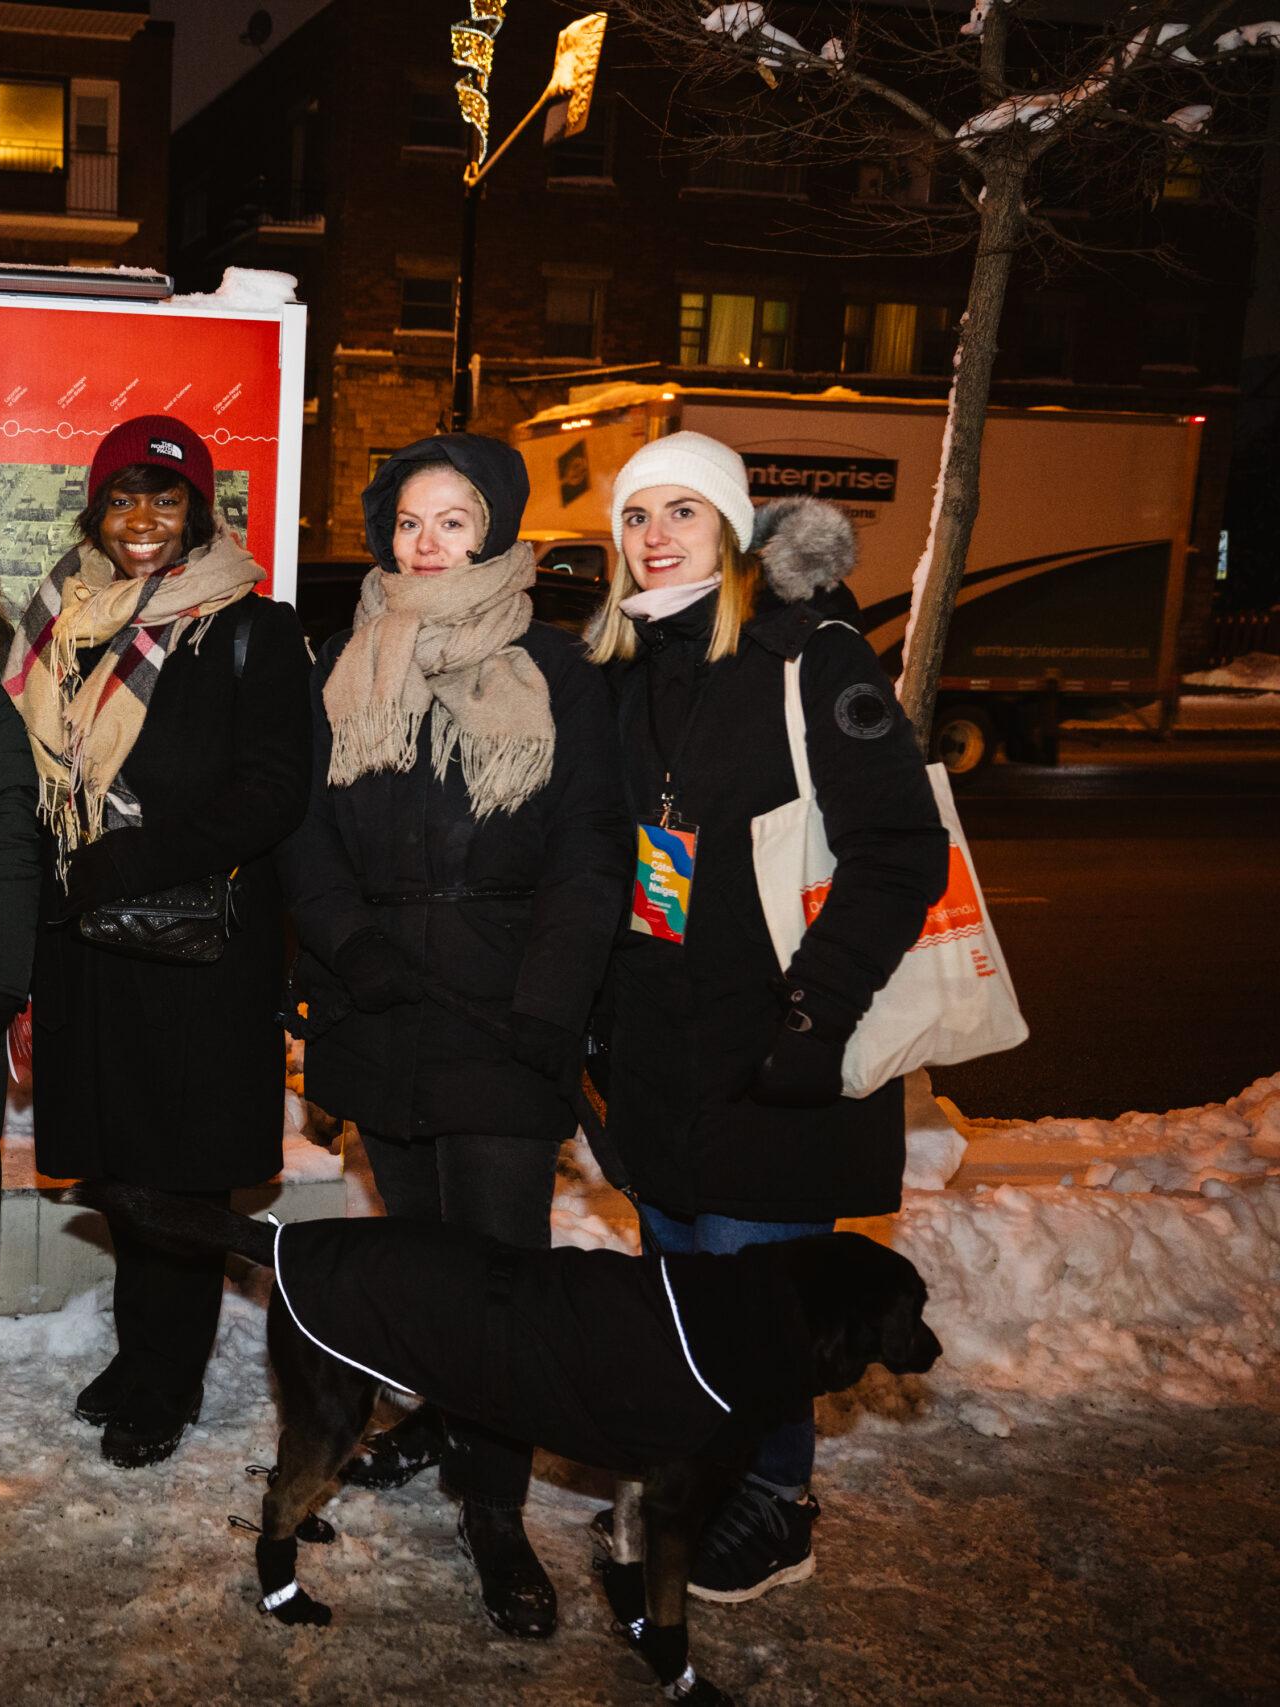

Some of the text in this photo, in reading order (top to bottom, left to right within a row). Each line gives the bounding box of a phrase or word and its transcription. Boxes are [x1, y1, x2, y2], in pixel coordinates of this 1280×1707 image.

[151, 444, 174, 453] NORTH
[160, 440, 174, 448] THE
[748, 464, 894, 493] nterprise
[648, 882, 678, 898] Neiges
